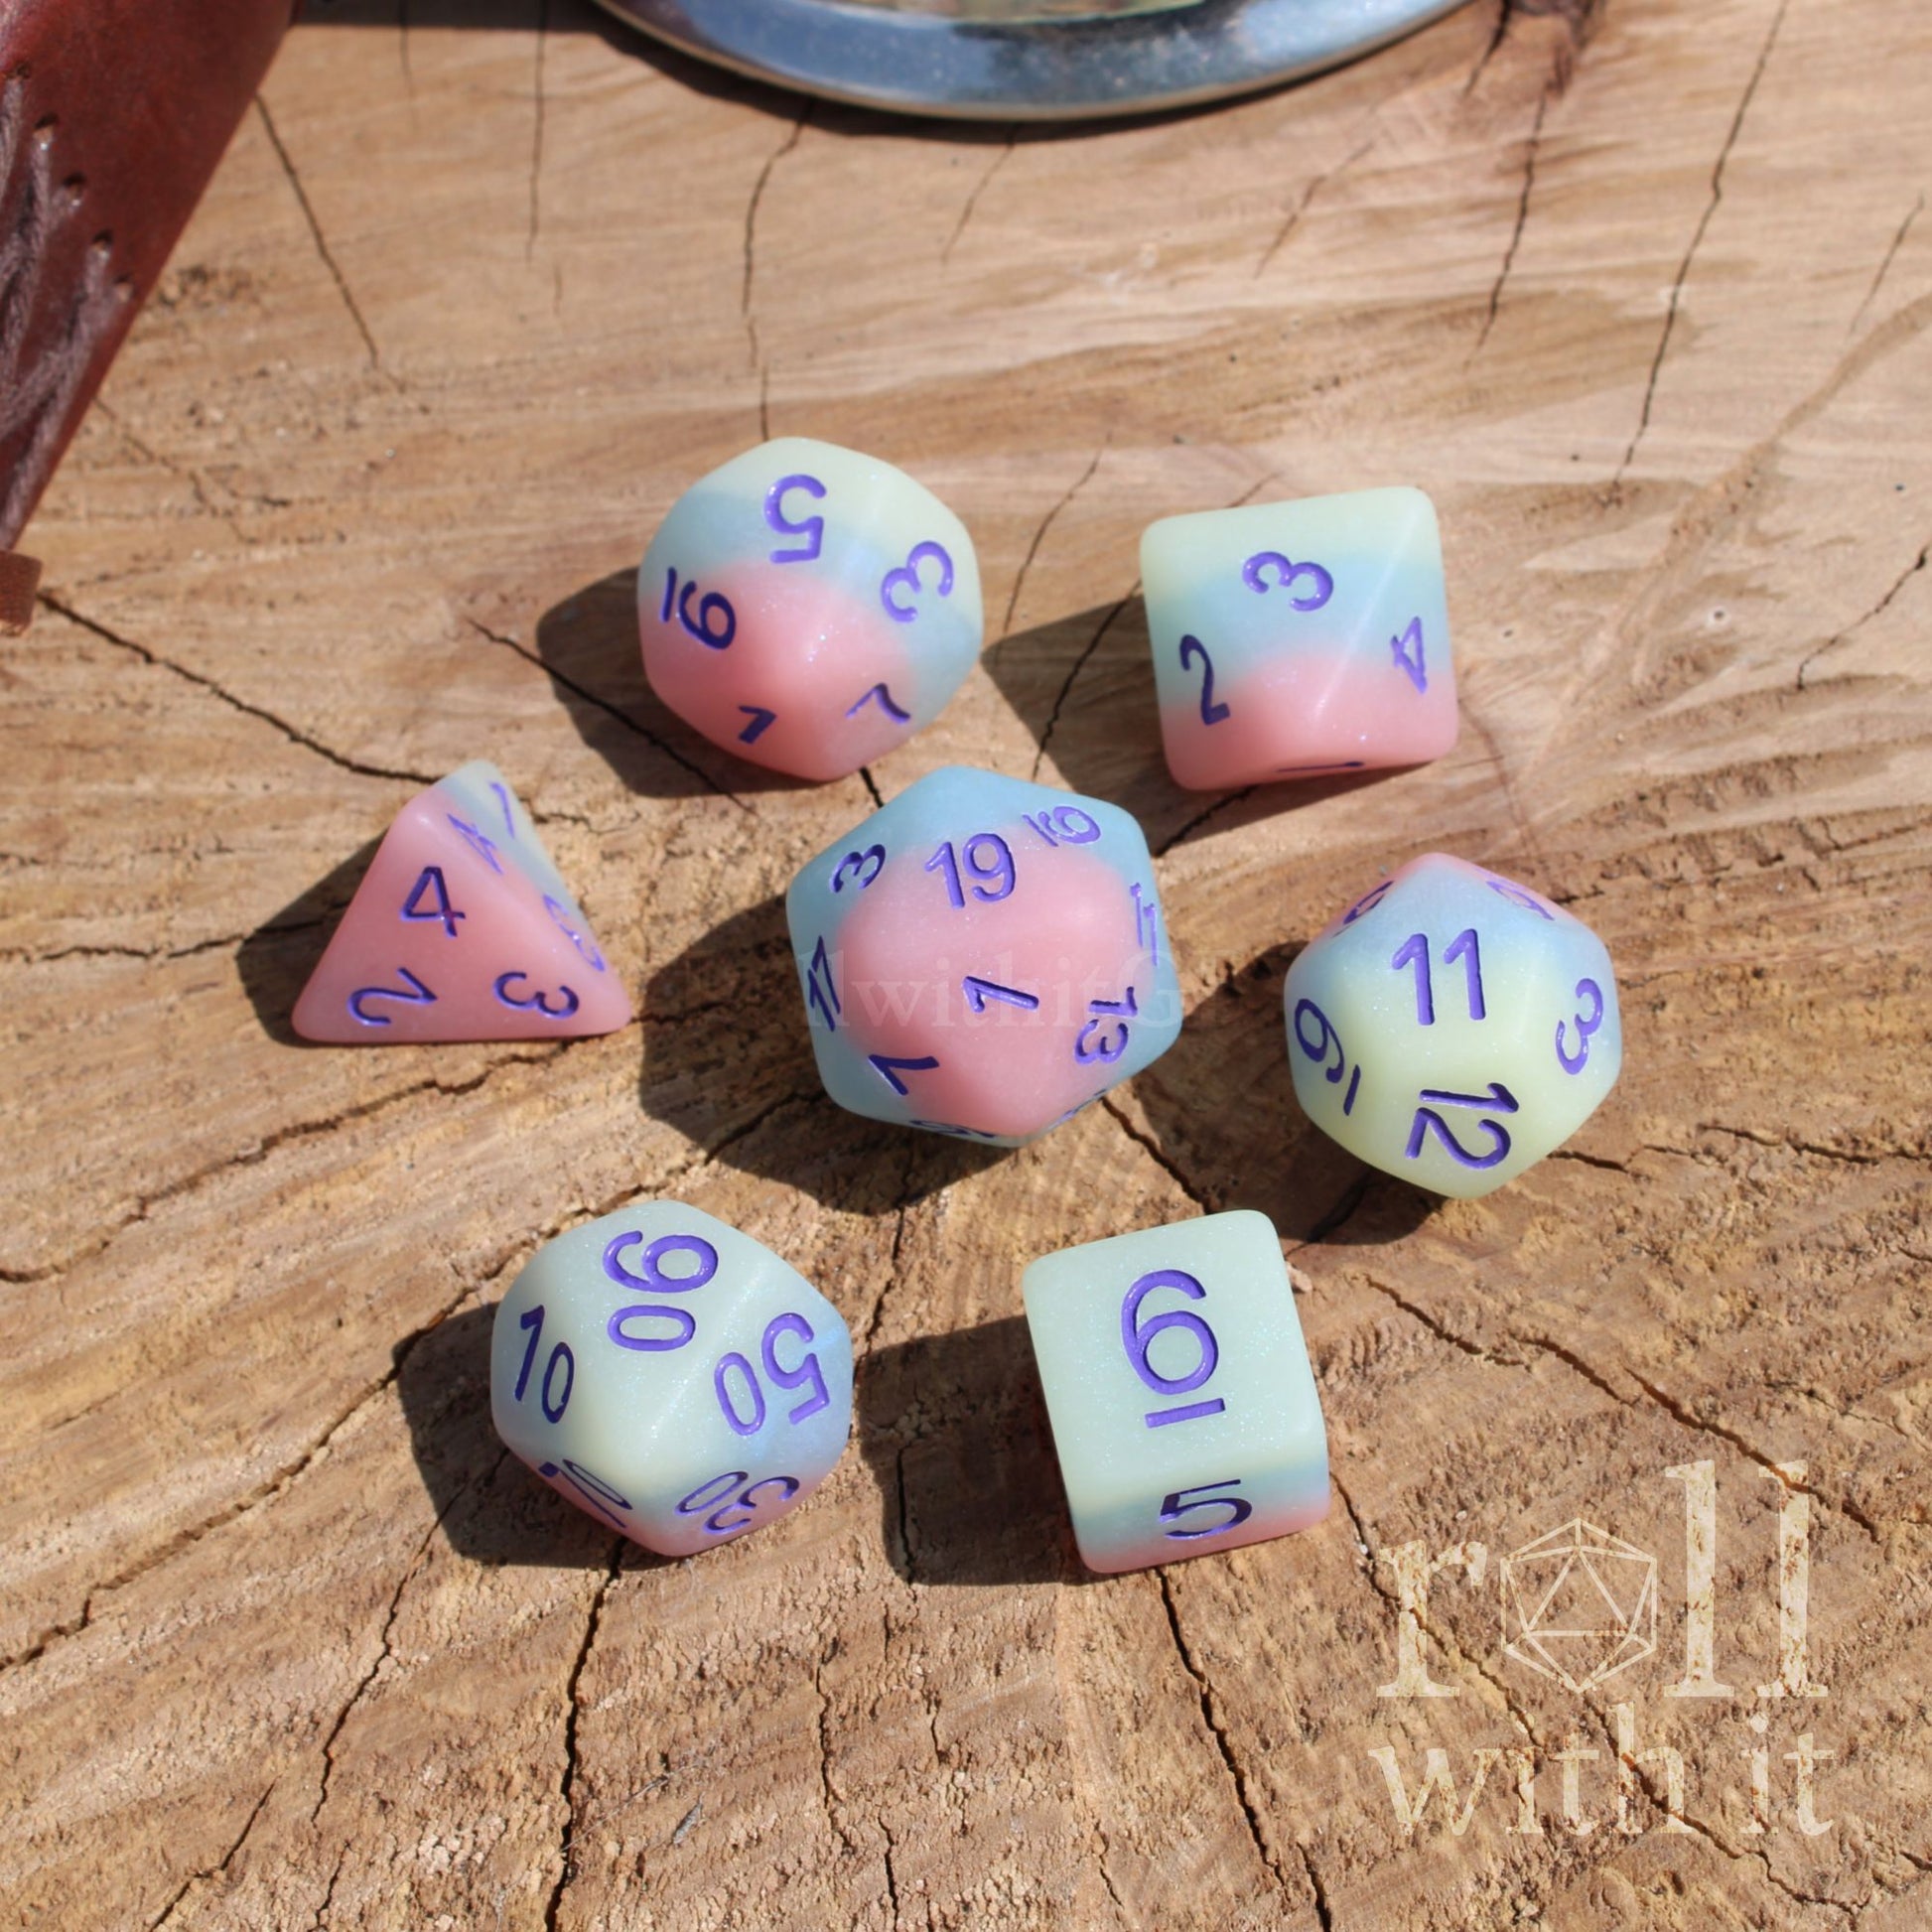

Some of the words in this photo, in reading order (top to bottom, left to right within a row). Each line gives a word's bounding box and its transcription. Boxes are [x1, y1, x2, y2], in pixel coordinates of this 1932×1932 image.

[763, 474, 827, 564] 5
[880, 541, 954, 622] 3
[1242, 551, 1333, 612] 3
[1179, 634, 1231, 726] 2
[1390, 616, 1428, 694] 4
[401, 866, 466, 937] 4
[829, 844, 886, 893] 3
[925, 833, 1016, 908] 19
[347, 967, 438, 1026] 2
[492, 971, 580, 1020] 3
[963, 975, 1039, 1013] 1
[1392, 928, 1486, 1027] 11
[1556, 978, 1603, 1075] 3
[1405, 1082, 1519, 1170] 12
[514, 1305, 575, 1424] 10
[714, 1312, 830, 1437] 50
[1121, 1269, 1227, 1429] 6
[1159, 1479, 1253, 1541] 5
